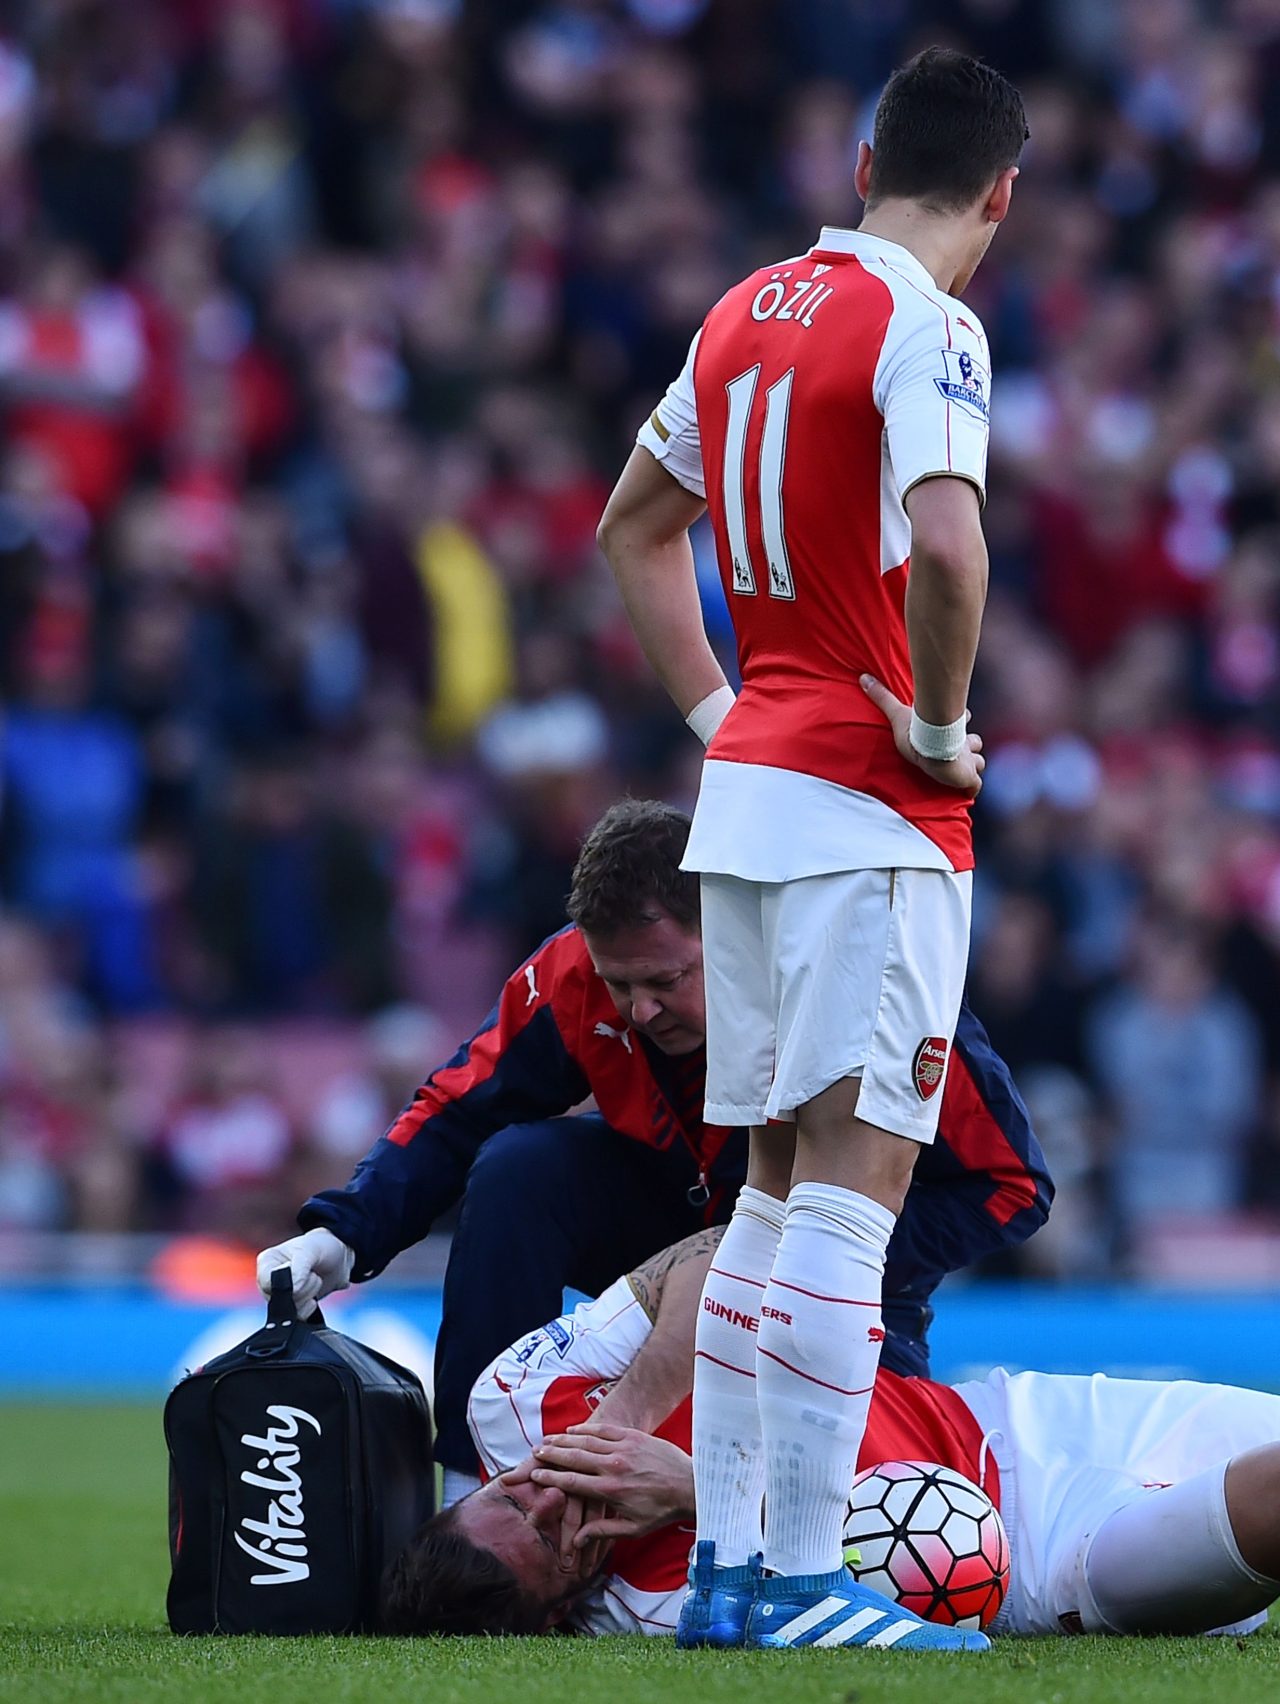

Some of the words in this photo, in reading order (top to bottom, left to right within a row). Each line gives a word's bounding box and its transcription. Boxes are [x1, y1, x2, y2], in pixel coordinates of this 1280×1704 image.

[751, 271, 834, 328] ÖZIL
[722, 363, 796, 601] 11
[234, 1405, 321, 1585] Vitality
